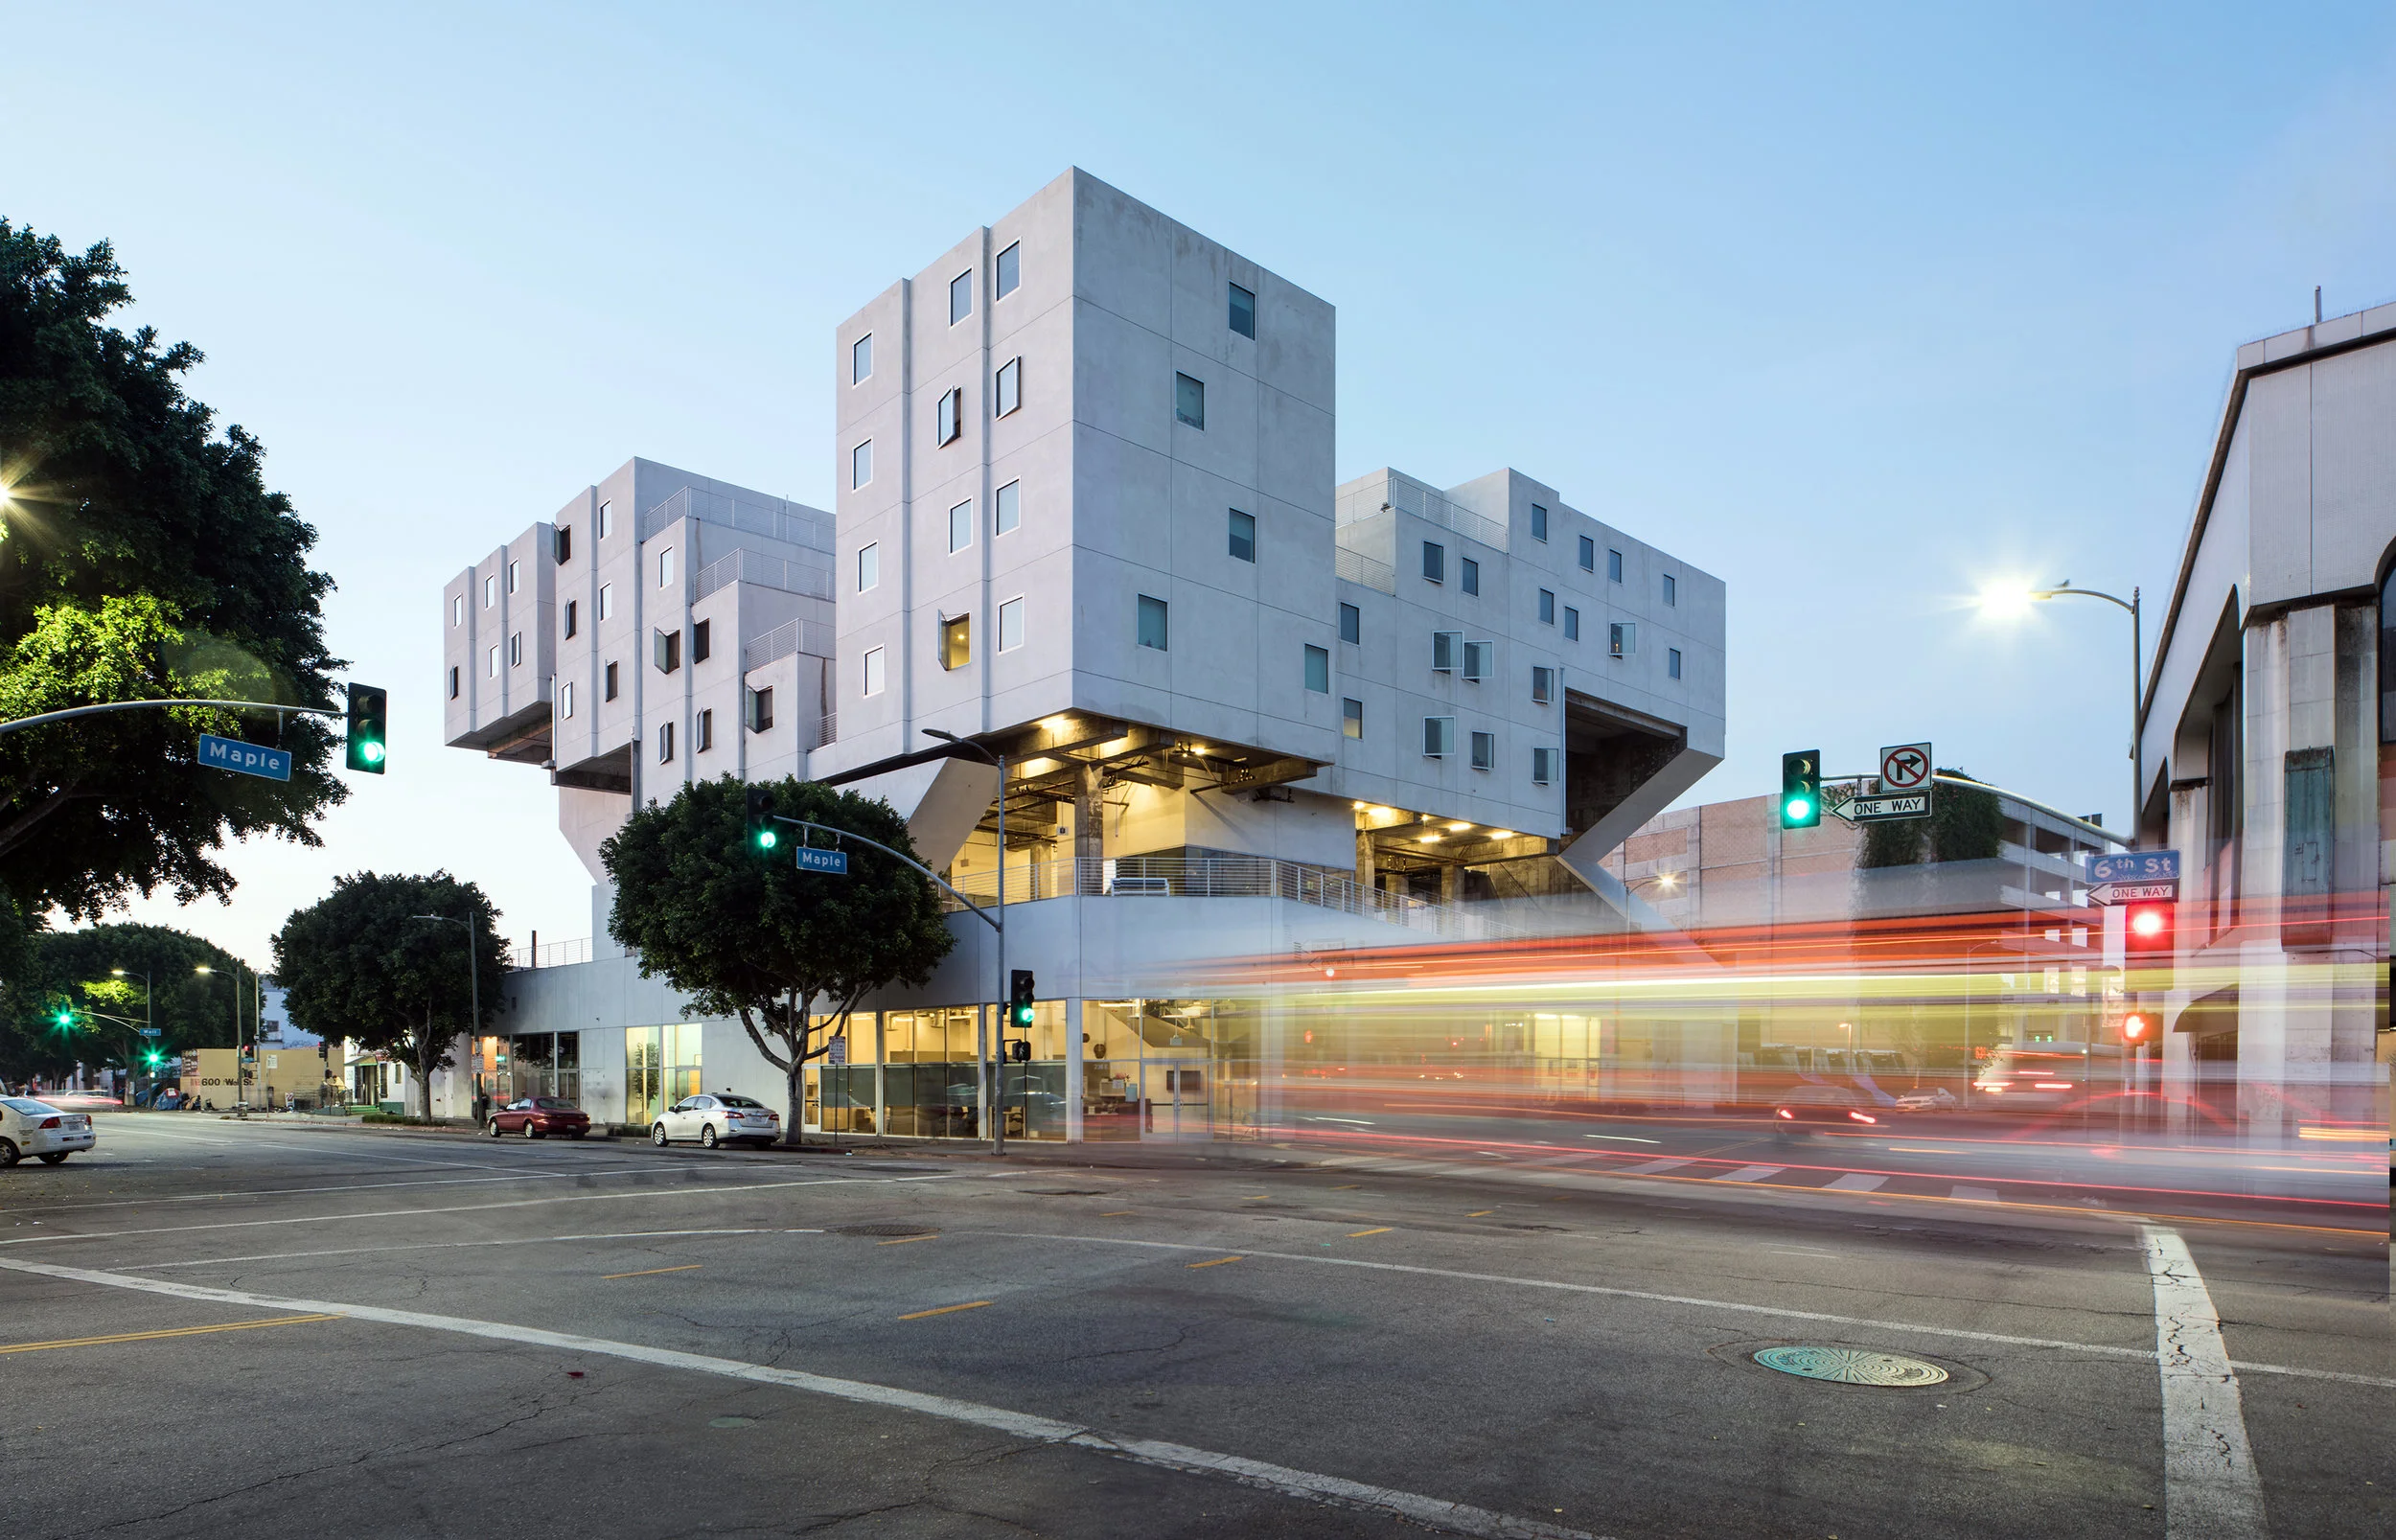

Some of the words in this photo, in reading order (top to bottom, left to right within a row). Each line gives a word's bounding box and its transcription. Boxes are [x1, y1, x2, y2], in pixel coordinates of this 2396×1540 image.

[210, 742, 280, 770] Maple
[1854, 802, 1882, 815] ONE
[1891, 798, 1922, 811] WAY
[802, 852, 841, 867] Maple
[2094, 859, 2134, 879] 6th
[2145, 858, 2171, 873] St
[2112, 887, 2137, 898] ONE
[2142, 887, 2168, 897] WAY
